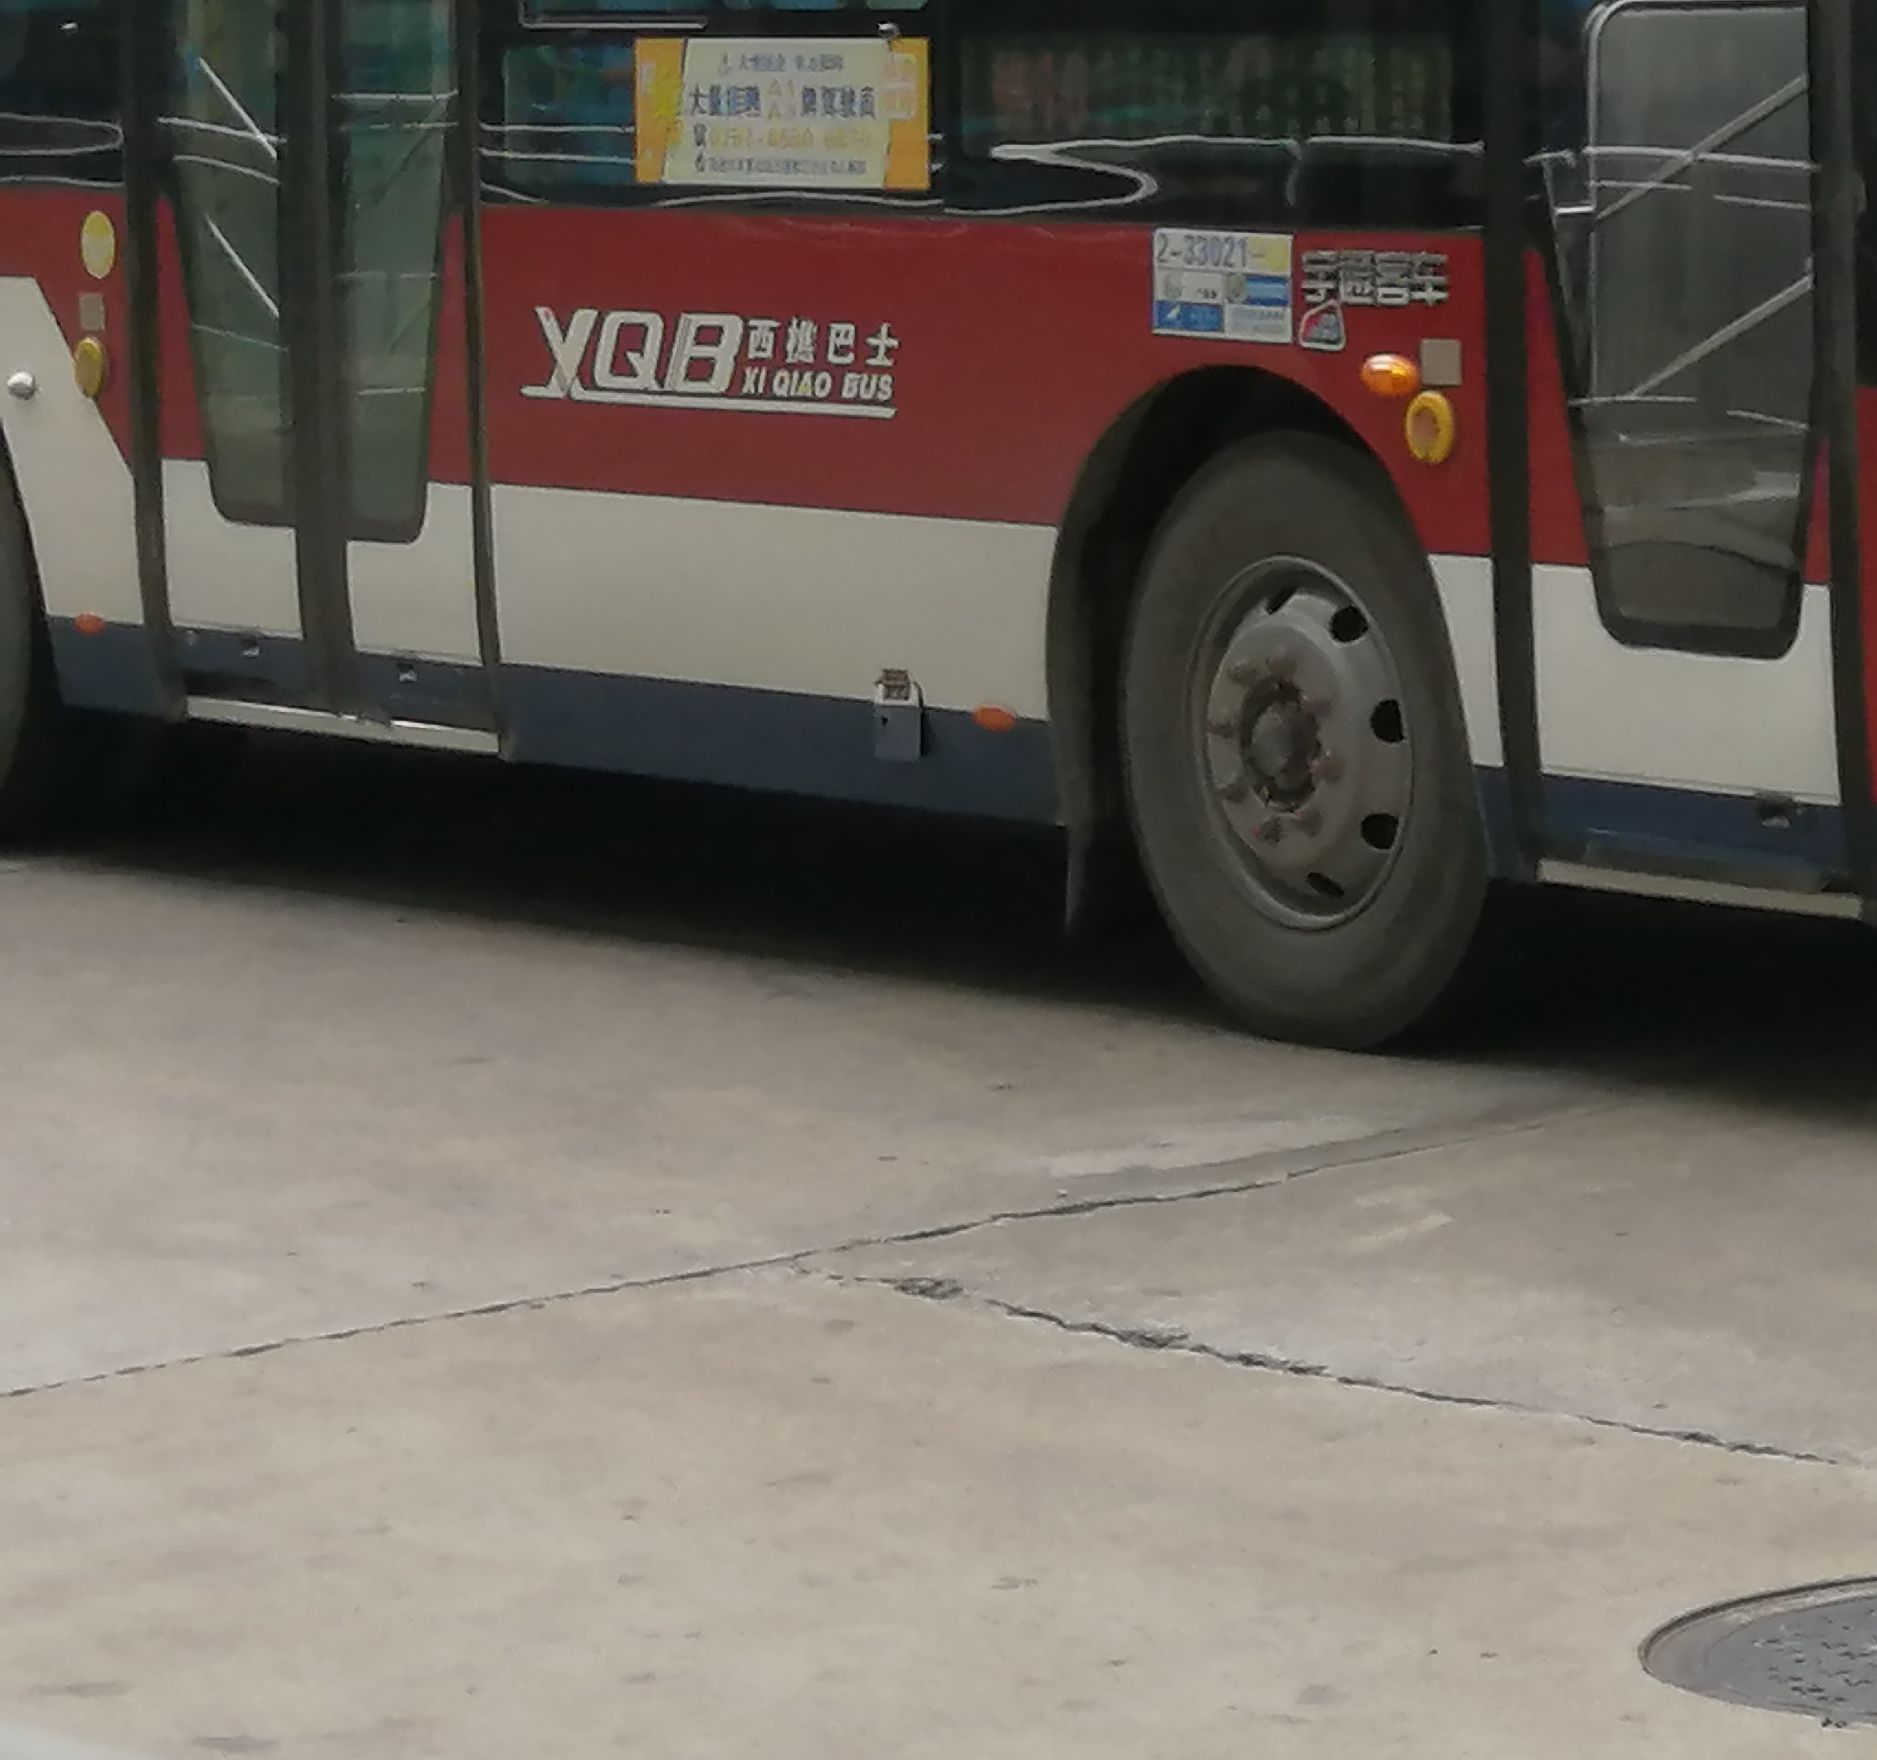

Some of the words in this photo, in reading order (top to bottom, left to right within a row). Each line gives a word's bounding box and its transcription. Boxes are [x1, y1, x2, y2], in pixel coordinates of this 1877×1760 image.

[741, 368, 767, 395] XI
[772, 370, 832, 399] QIAO
[841, 371, 893, 401] BUS
